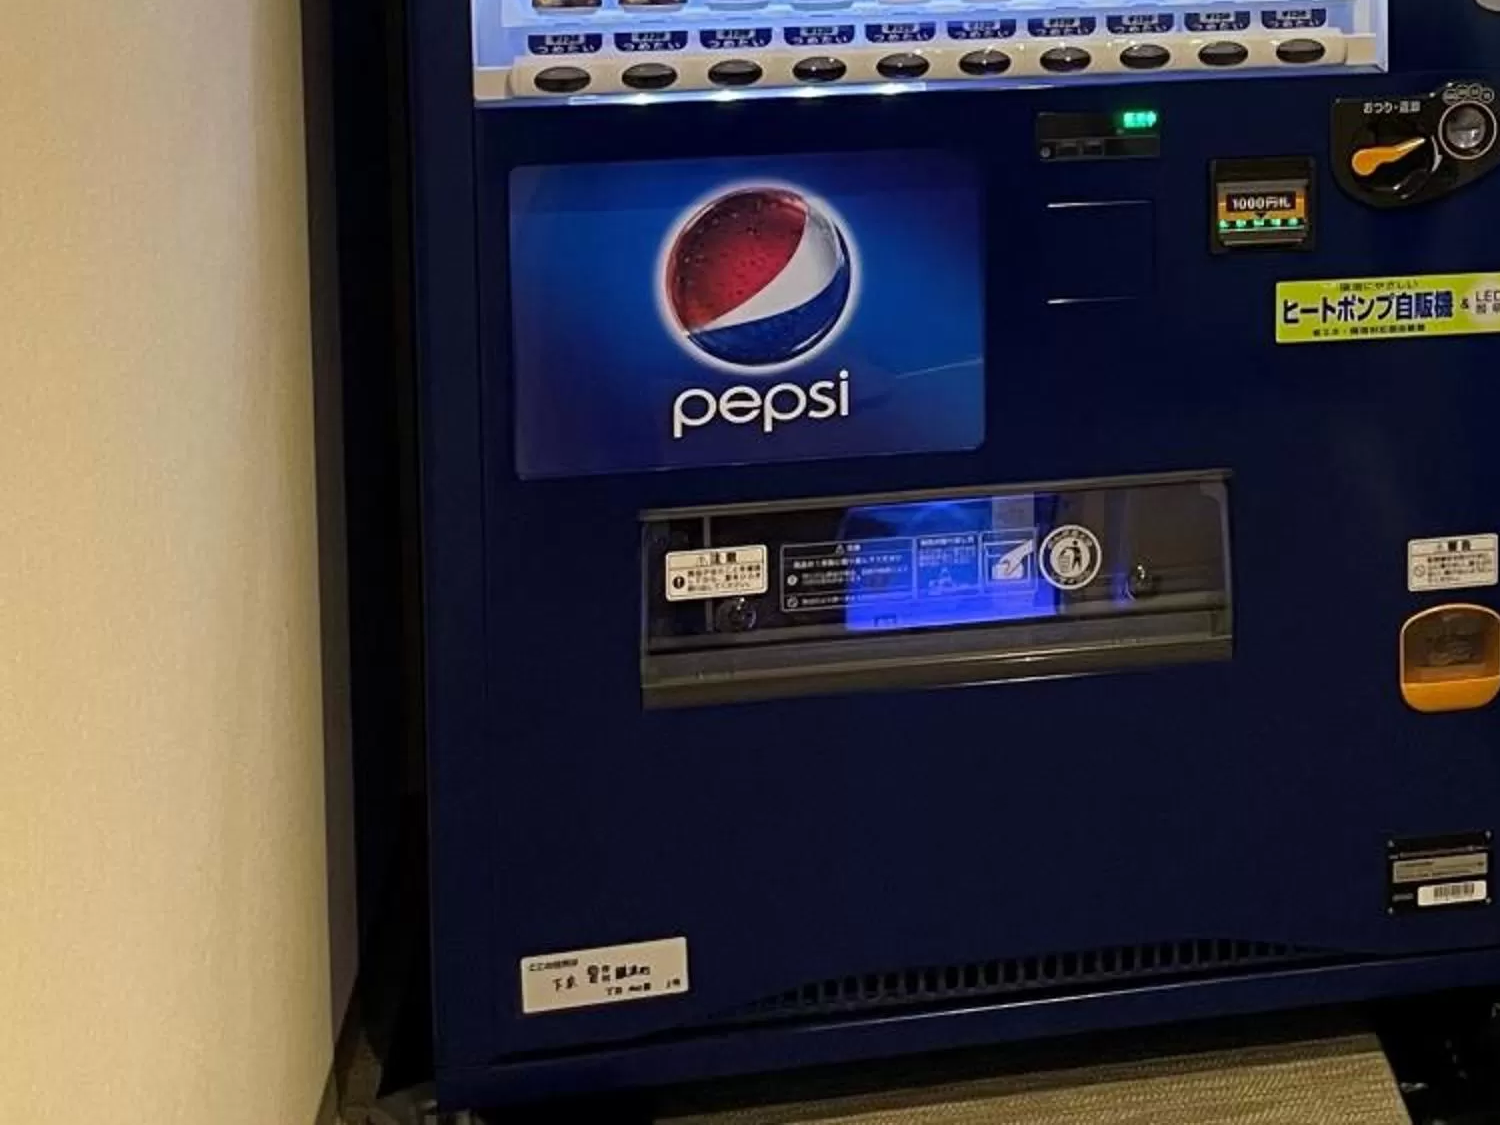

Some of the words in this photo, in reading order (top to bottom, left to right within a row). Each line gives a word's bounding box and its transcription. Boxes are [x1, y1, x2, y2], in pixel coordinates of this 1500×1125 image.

[1233, 196, 1291, 210] 1000円札
[1283, 290, 1453, 324] ヒートポンプ自販機
[673, 369, 849, 438] pepsi
